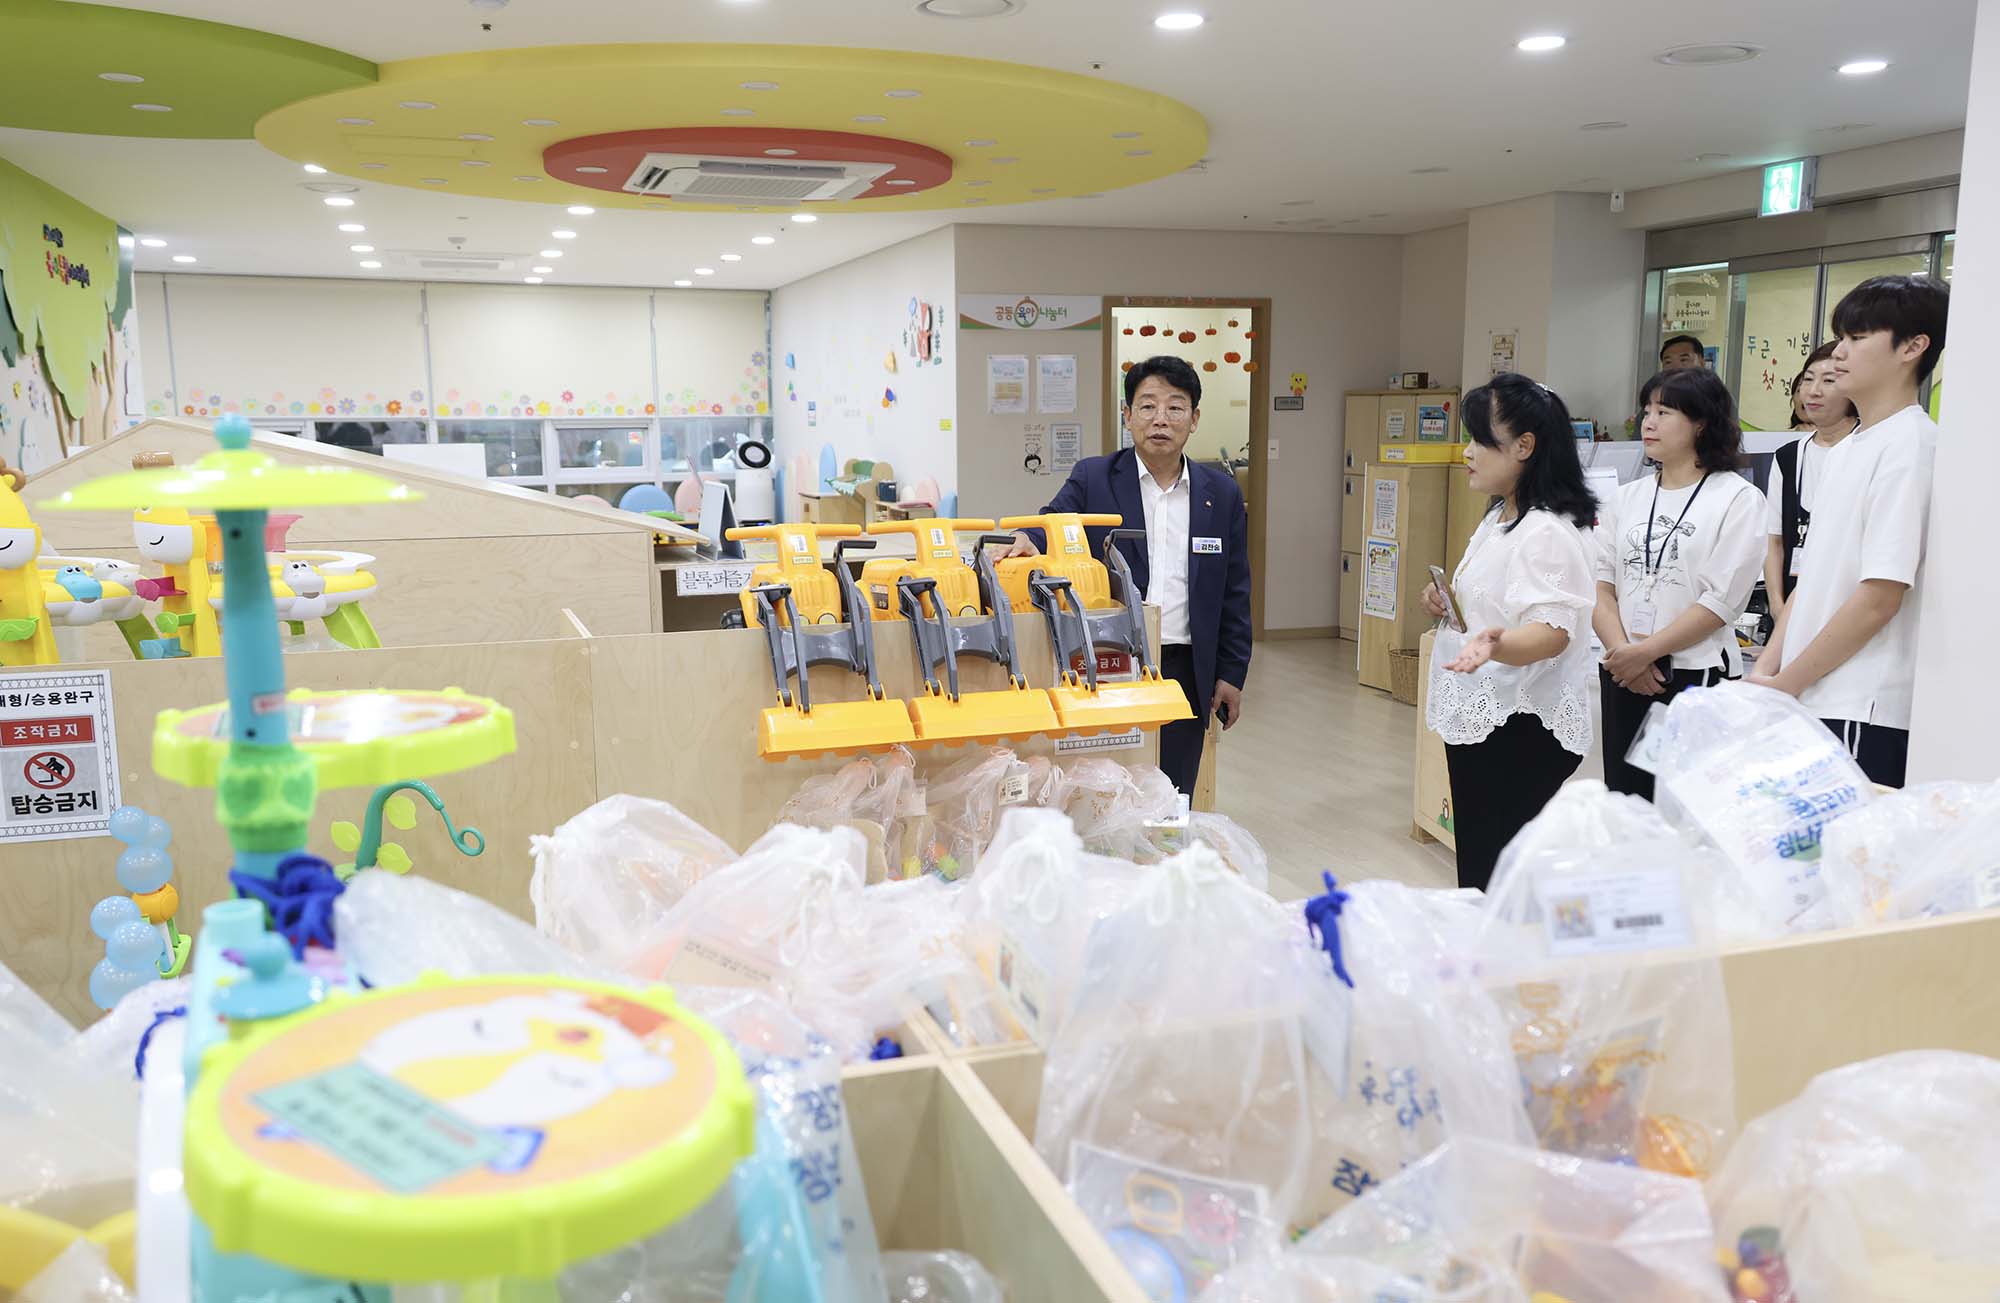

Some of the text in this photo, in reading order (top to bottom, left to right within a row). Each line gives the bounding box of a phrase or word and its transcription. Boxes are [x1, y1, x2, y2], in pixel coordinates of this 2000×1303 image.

[1038, 305, 1068, 321] 나눔터
[1077, 657, 1121, 671] 조금지
[13, 723, 79, 740] 조작금지
[11, 789, 99, 816] 탑승금지
